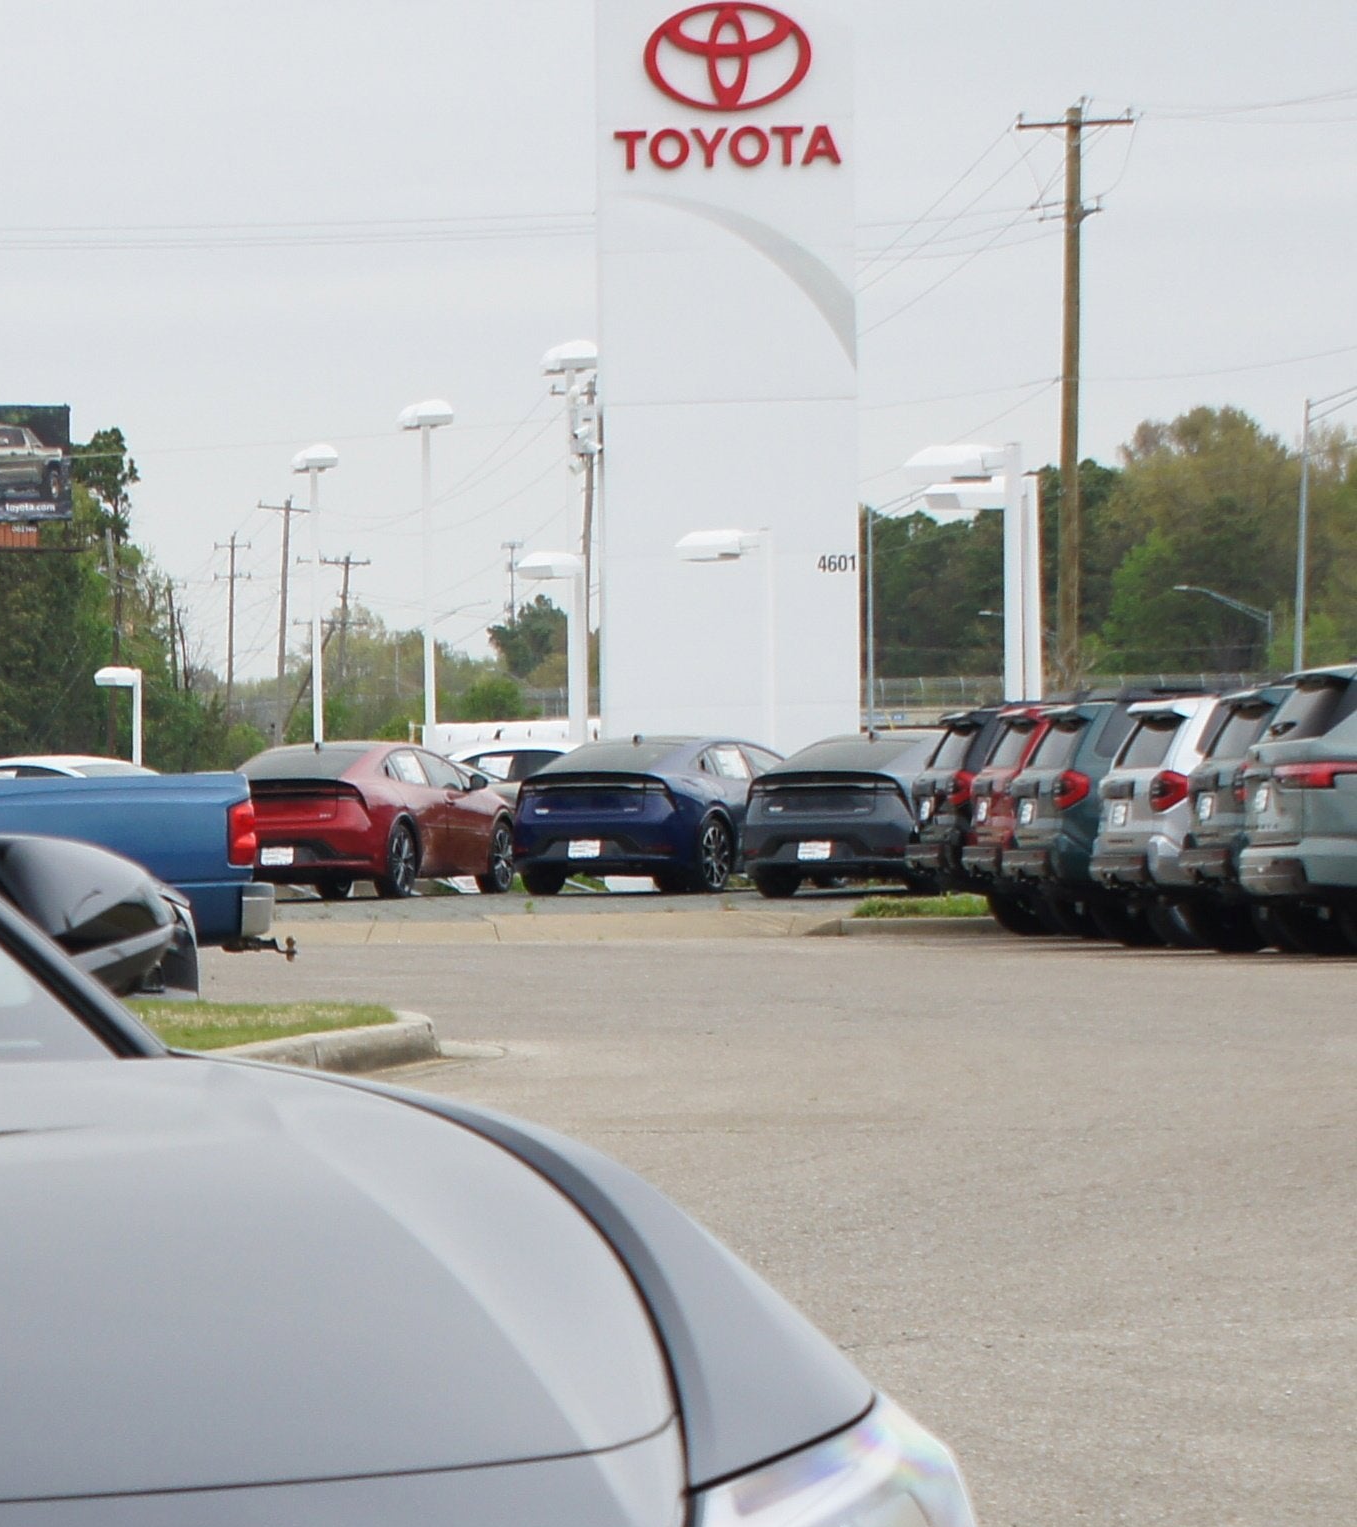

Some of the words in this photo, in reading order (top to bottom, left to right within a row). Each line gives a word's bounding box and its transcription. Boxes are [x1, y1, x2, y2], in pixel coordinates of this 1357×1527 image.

[613, 125, 841, 171] TOYOTA
[5, 503, 55, 514] toyota.com
[817, 554, 856, 572] 4601
